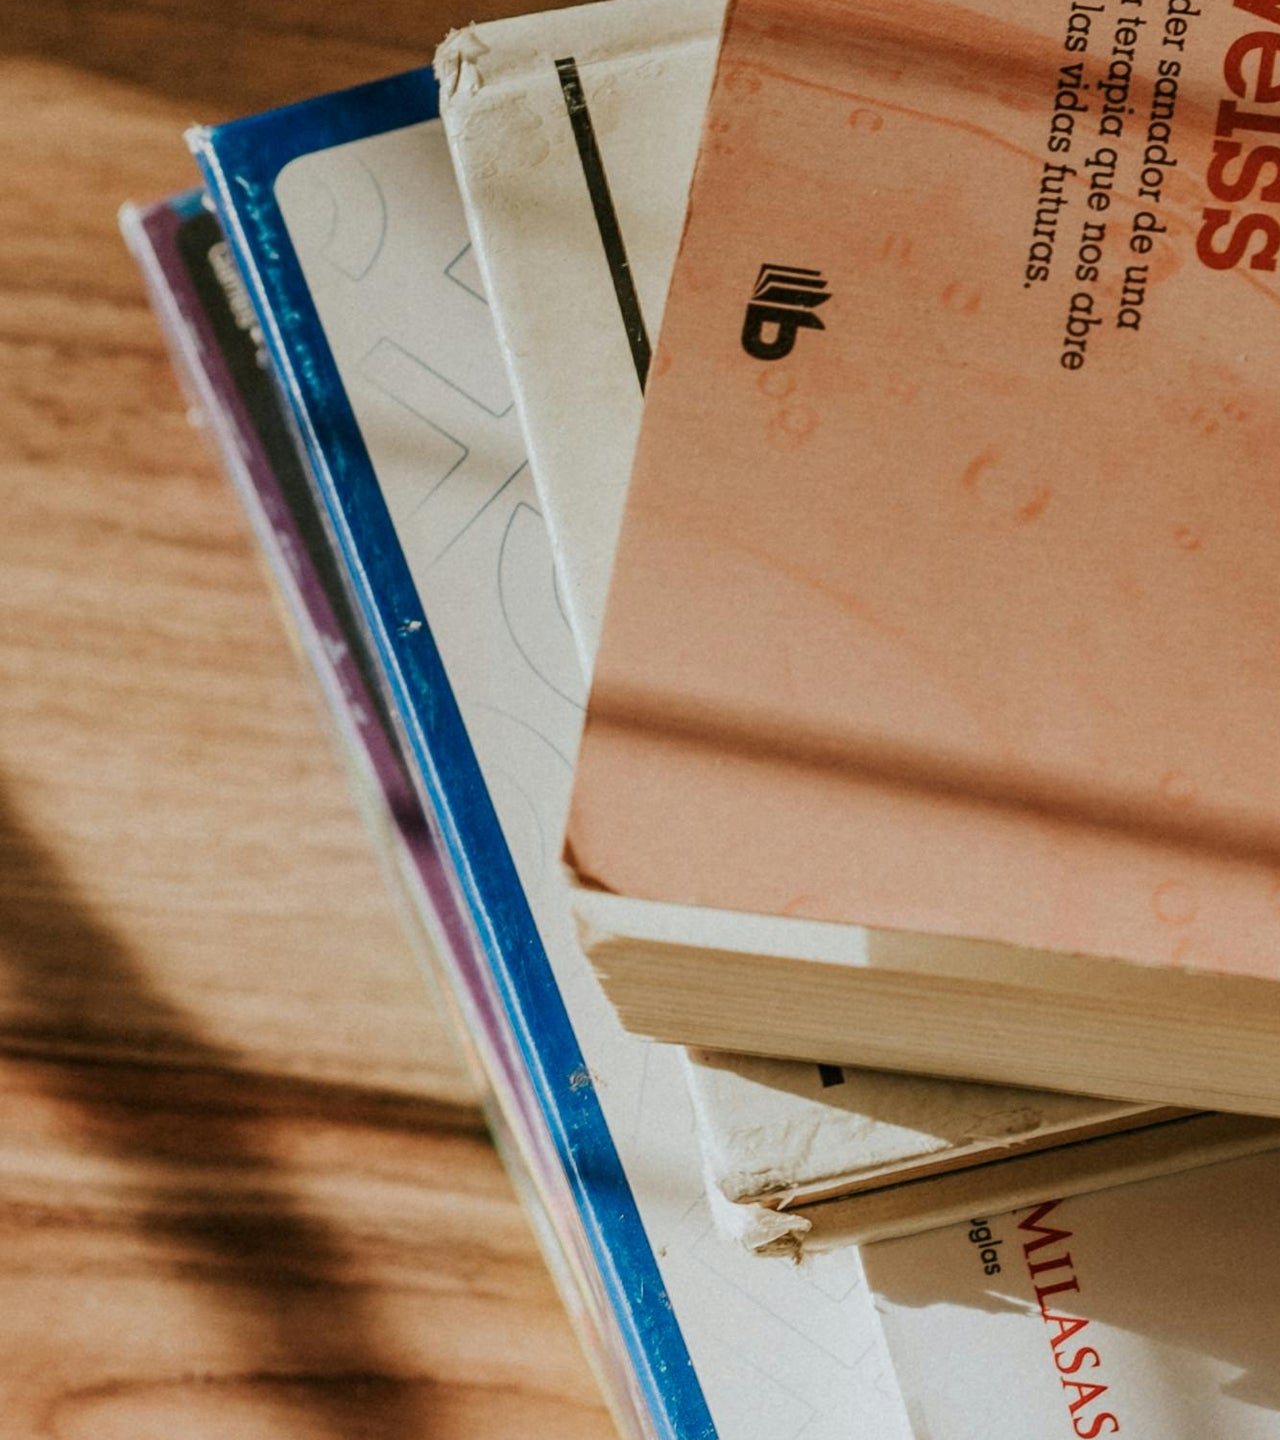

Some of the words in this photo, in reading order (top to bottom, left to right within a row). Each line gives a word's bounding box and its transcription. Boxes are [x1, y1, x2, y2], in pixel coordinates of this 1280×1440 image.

[1063, 1, 1105, 52] las
[1047, 62, 1090, 152] vidas
[1095, 16, 1147, 137] terapia
[1137, 59, 1181, 203] sanador
[1084, 147, 1117, 211] que
[1023, 161, 1077, 288] futuras.
[1074, 221, 1106, 282] nos
[1128, 211, 1167, 254] de
[1060, 291, 1103, 370] abre
[1115, 264, 1148, 331] una
[967, 1216, 1002, 1275] uglas
